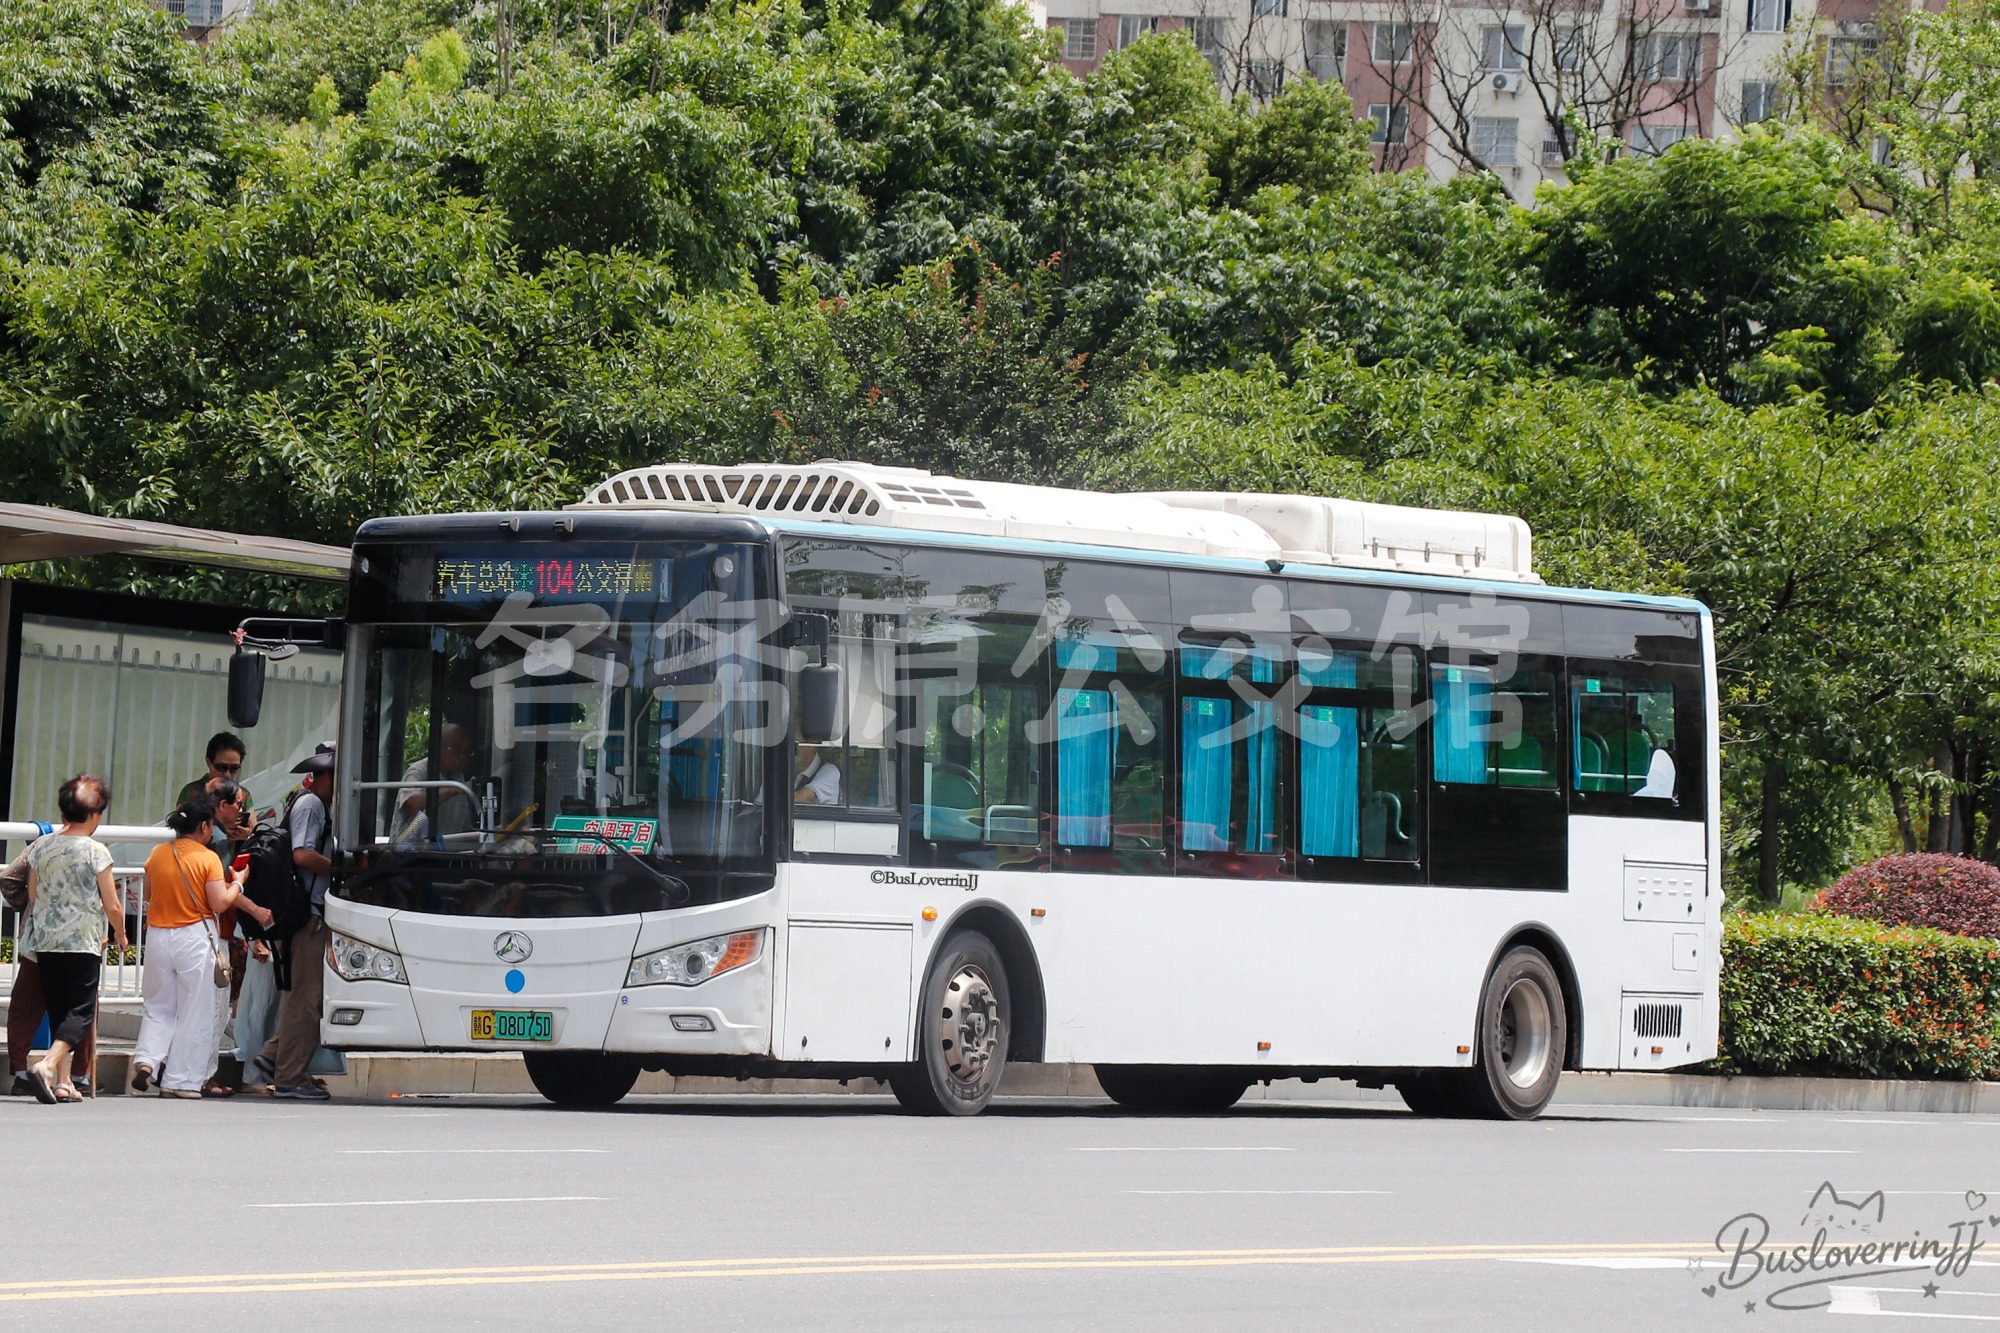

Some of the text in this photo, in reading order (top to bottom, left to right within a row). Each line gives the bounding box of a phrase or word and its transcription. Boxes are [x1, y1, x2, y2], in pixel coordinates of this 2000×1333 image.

[437, 560, 516, 594] 汽车总站
[536, 560, 574, 594] 104
